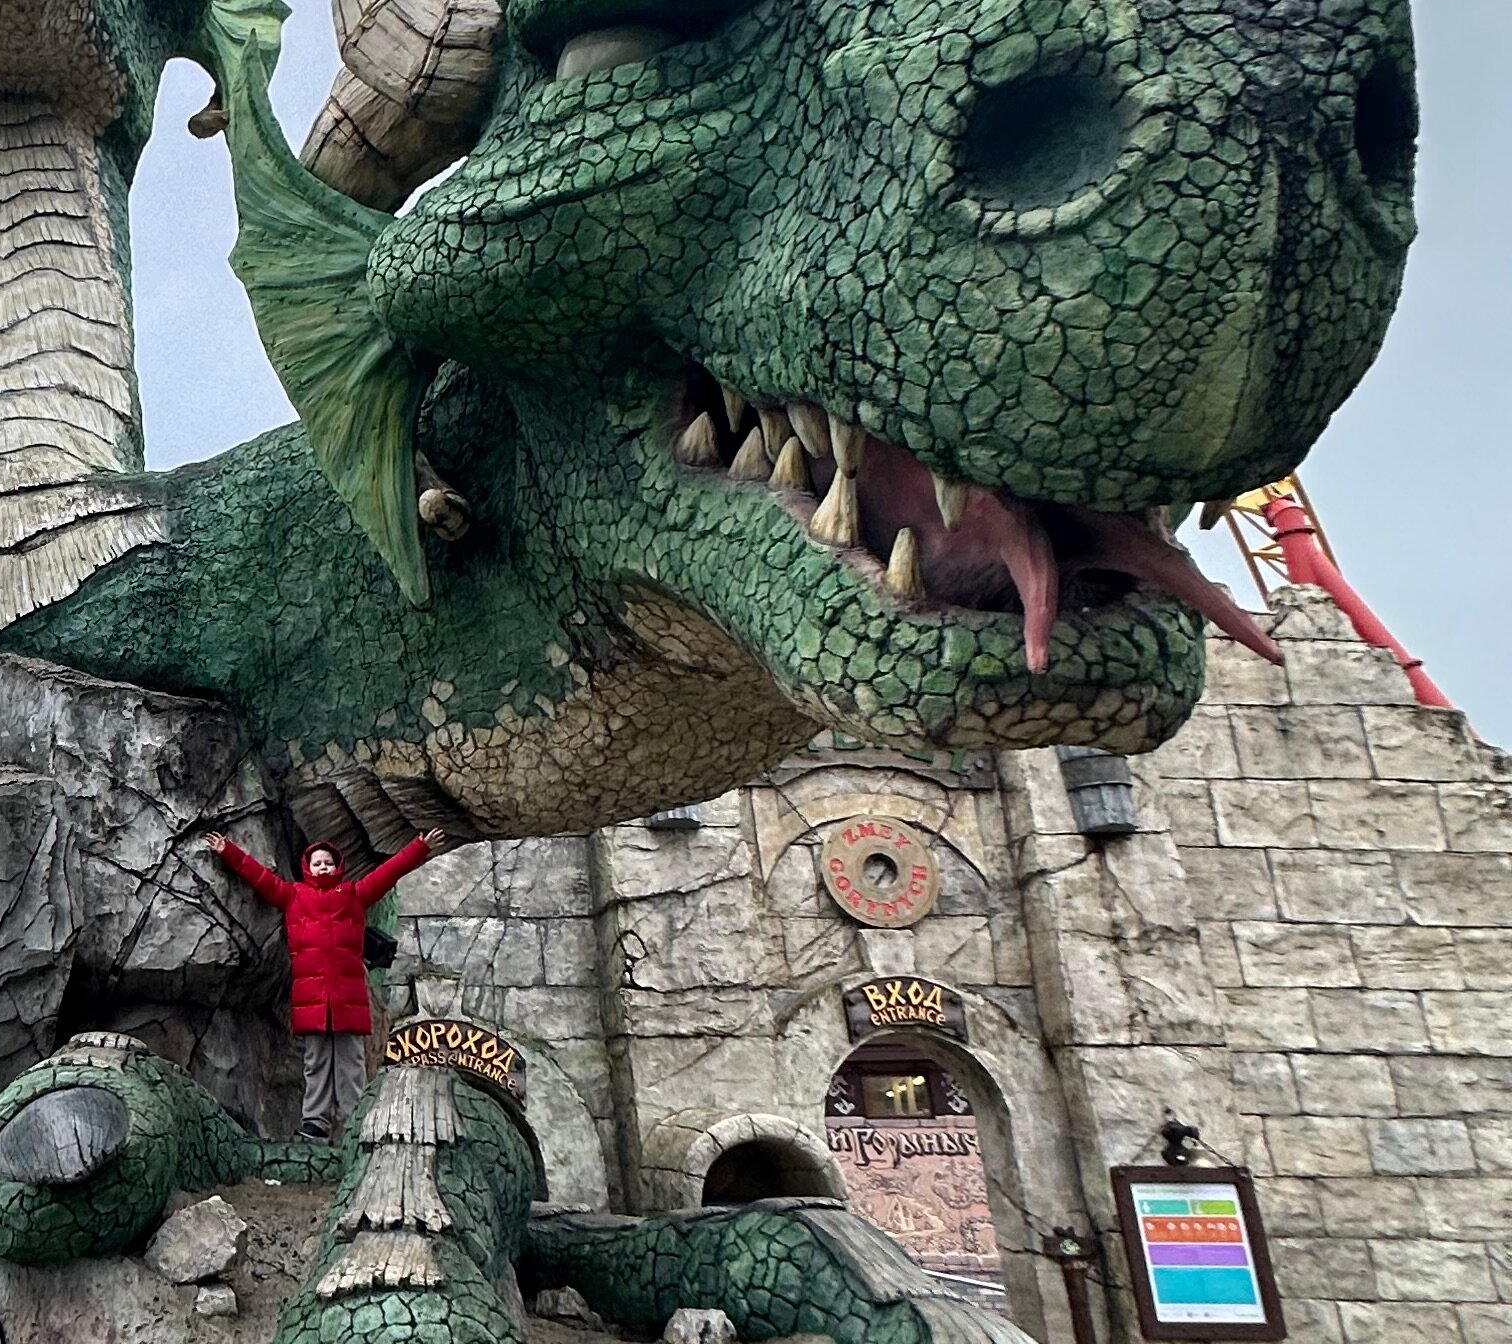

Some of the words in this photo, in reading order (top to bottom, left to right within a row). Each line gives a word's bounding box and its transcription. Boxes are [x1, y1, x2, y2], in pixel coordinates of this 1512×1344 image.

[842, 822, 912, 848] ZMEY
[862, 981, 942, 1012] ВХОД
[386, 1023, 514, 1073] СКОРОХОД
